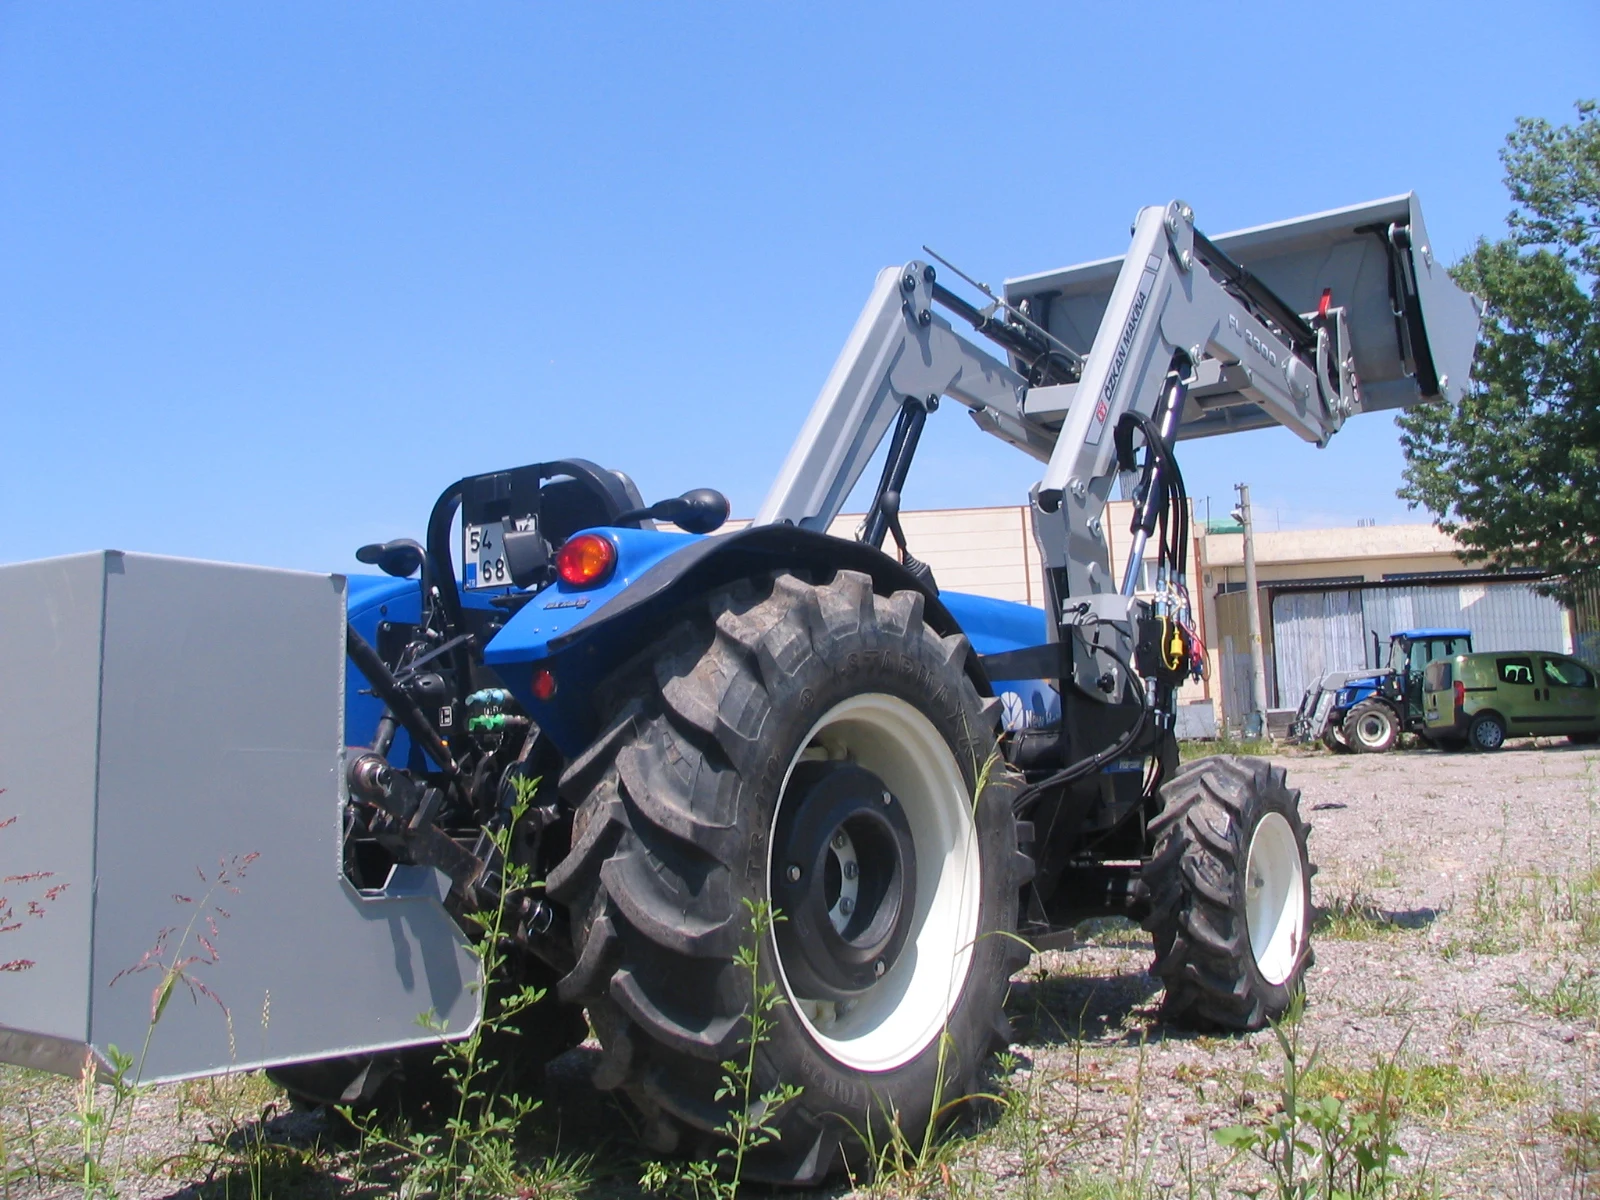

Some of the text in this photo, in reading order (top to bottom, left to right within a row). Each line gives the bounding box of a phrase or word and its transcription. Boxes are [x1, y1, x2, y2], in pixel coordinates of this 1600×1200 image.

[1228, 313, 1242, 338] FL
[1104, 345, 1127, 399] ÖZKAN
[470, 531, 492, 552] 54
[483, 558, 504, 582] 68
